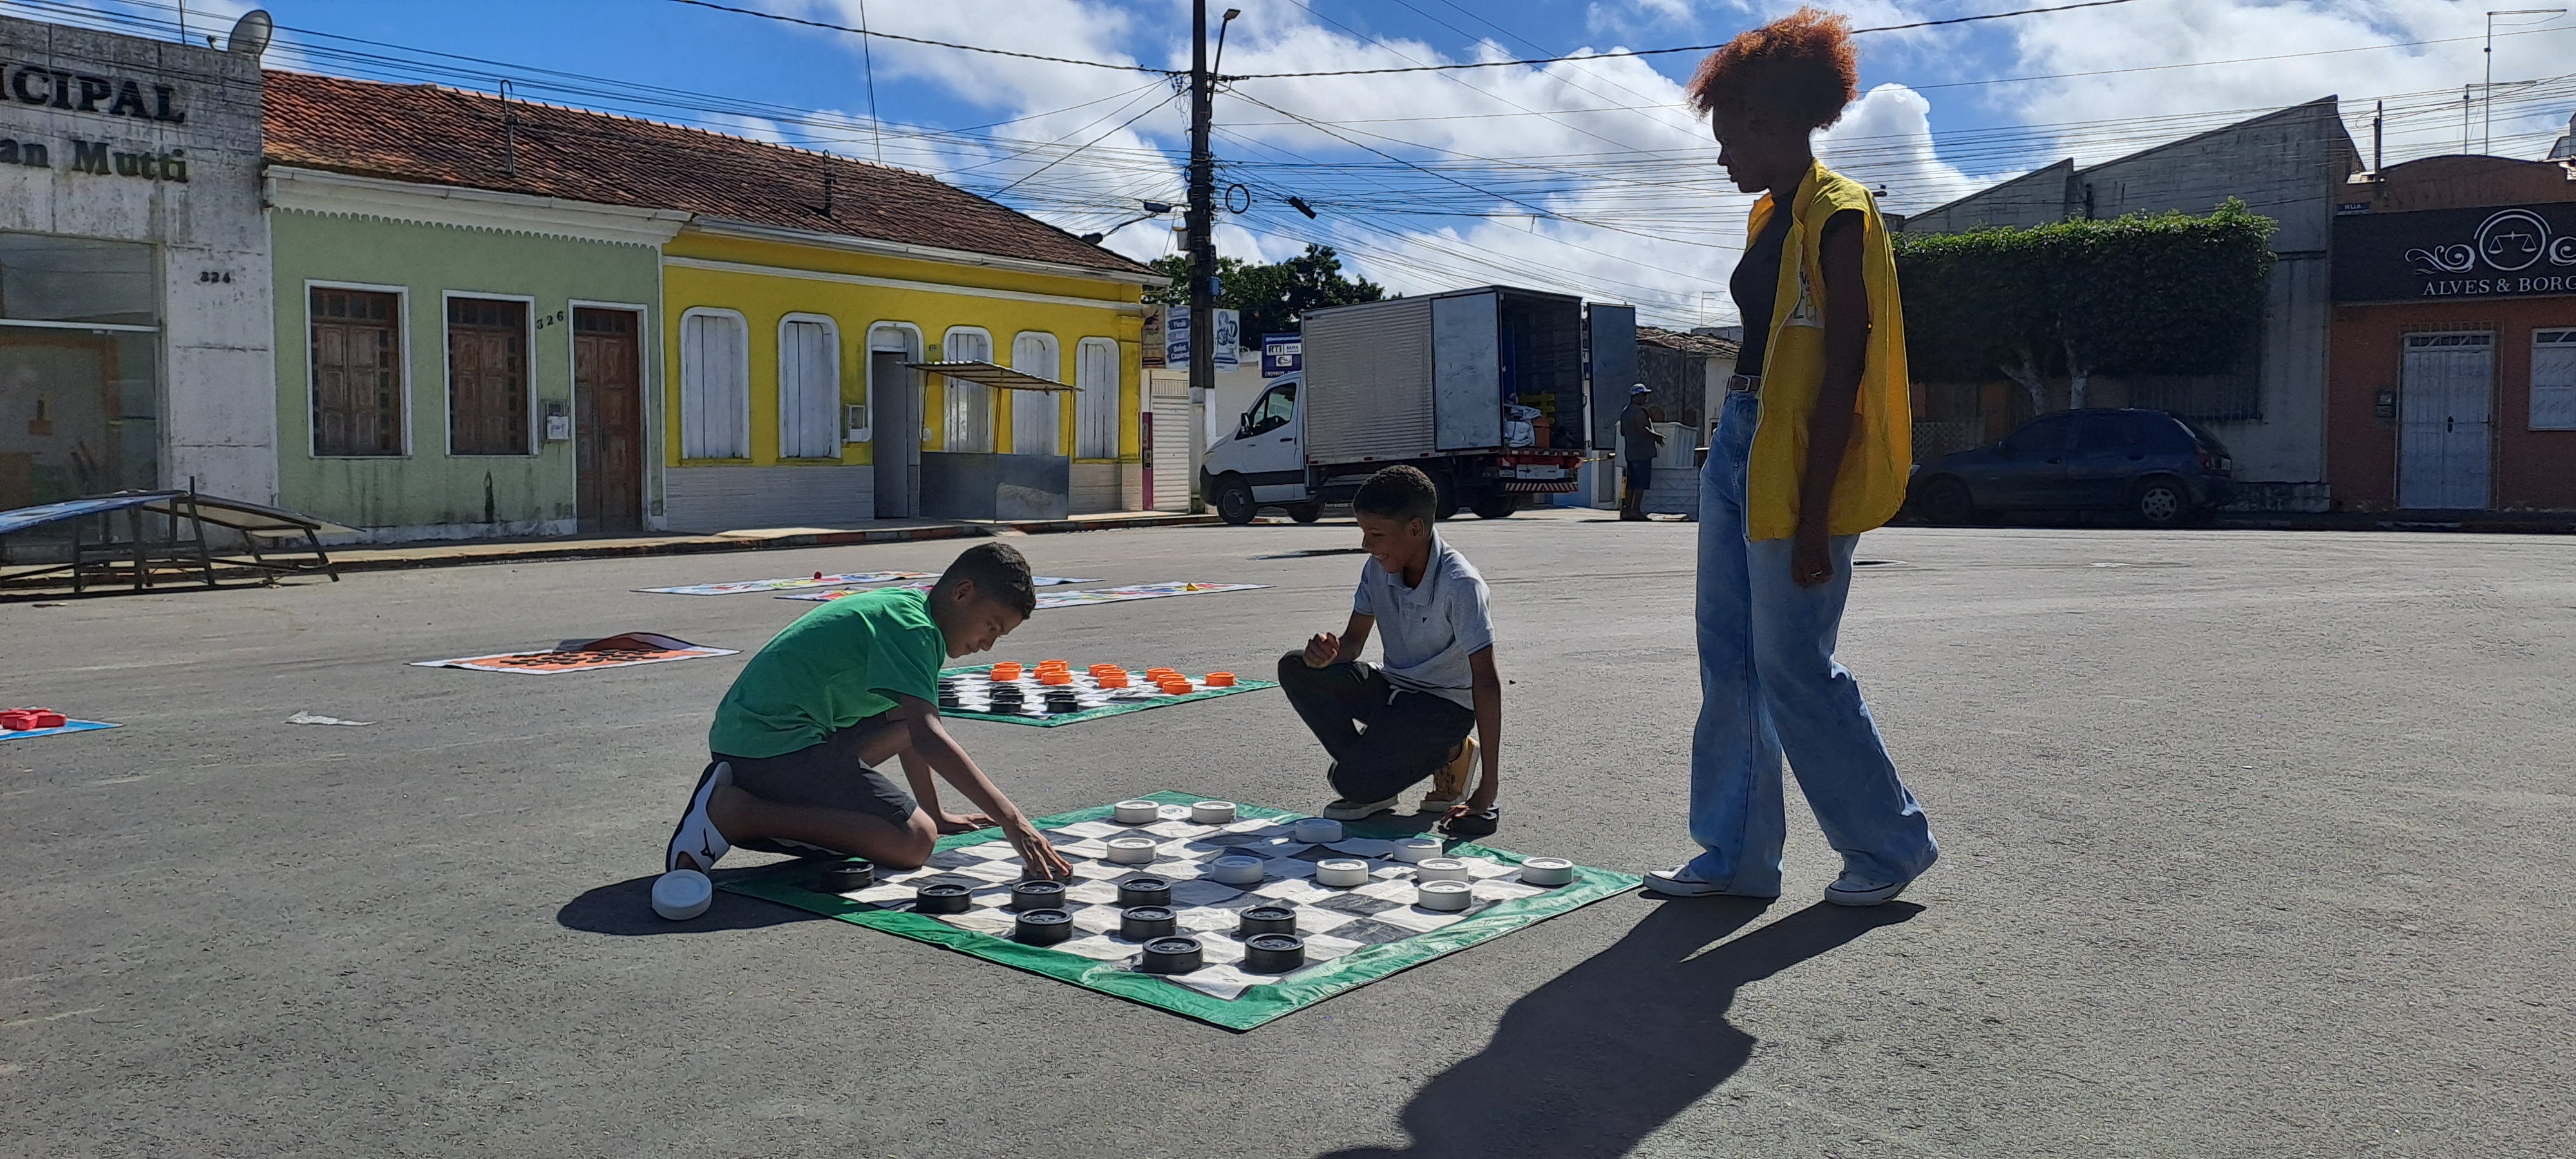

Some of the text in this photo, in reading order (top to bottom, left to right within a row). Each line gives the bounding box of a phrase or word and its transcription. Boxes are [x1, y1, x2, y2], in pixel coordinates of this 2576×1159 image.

[71, 140, 189, 184] Mutti
[2423, 279, 2490, 296] ALVES
[2496, 278, 2512, 292] &
[536, 311, 564, 330] 326
